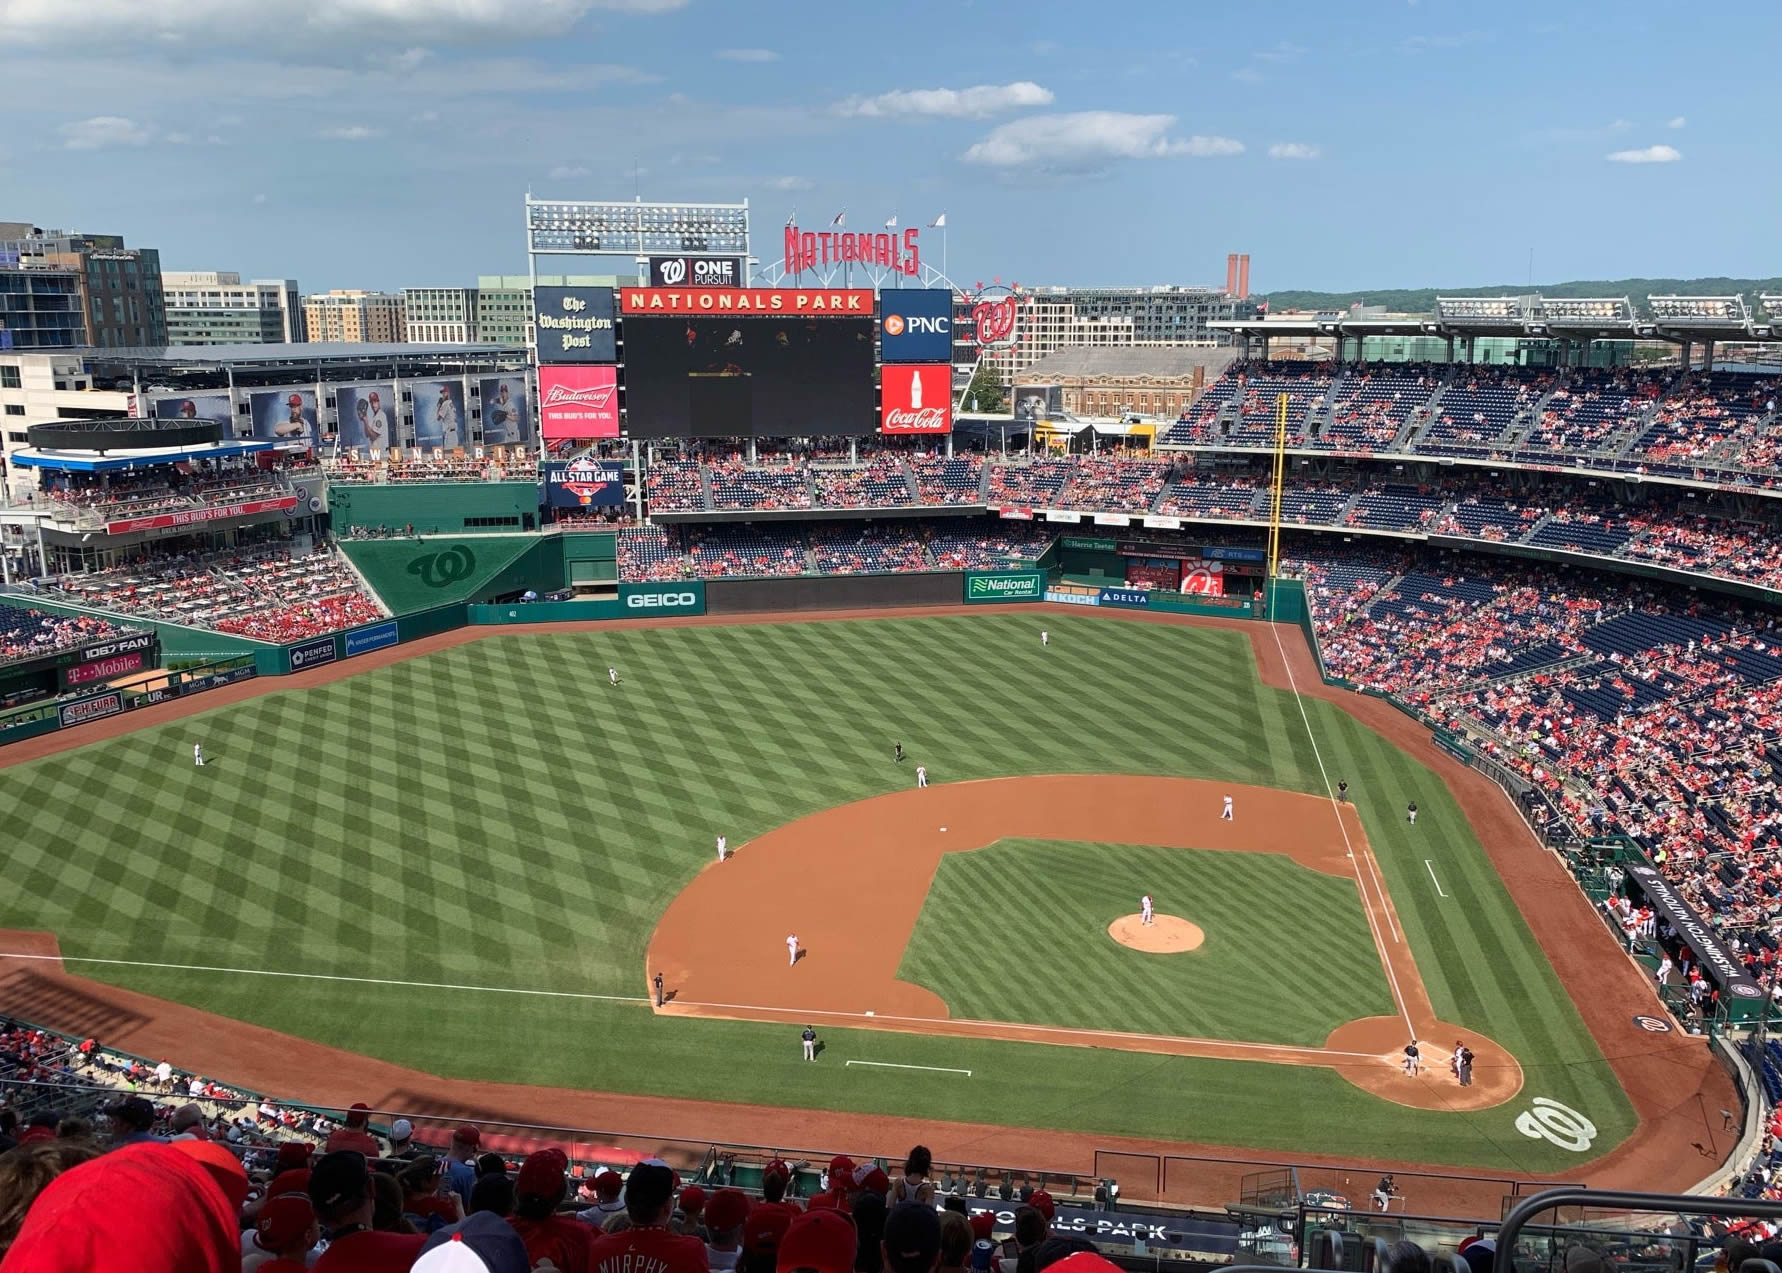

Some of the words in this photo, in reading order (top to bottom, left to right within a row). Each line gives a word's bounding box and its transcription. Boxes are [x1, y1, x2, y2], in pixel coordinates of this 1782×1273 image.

[784, 226, 919, 276] NATIONALS
[695, 261, 733, 275] ONE
[695, 274, 733, 285] PURSUIT
[562, 296, 587, 312] The
[631, 293, 783, 309] NATIONALS
[796, 295, 862, 310] PARK
[539, 313, 612, 332] Washington
[907, 316, 949, 334] PNC
[562, 334, 591, 351] Post
[548, 389, 608, 401] Budweiser
[548, 412, 562, 420] THIS
[584, 412, 597, 420] FOR
[886, 407, 947, 429] Coca-Cola
[550, 471, 567, 483] ALL
[568, 471, 593, 482] STAR
[594, 471, 619, 482] GAME
[172, 514, 189, 524] THIS
[190, 511, 213, 522] BUD'S
[214, 508, 228, 519] FOR
[987, 578, 1035, 590] National
[627, 592, 696, 608] GEICO
[1113, 593, 1147, 603] DELTA
[120, 637, 149, 651] FAN
[304, 645, 333, 657] PENFED
[189, 680, 206, 689] MGM
[234, 668, 251, 677] MGM
[91, 696, 117, 712] FURR
[1648, 879, 1692, 926] NATIONALS
[1687, 924, 1742, 977] WASHINGTON
[599, 1254, 668, 1273] MURPHY
